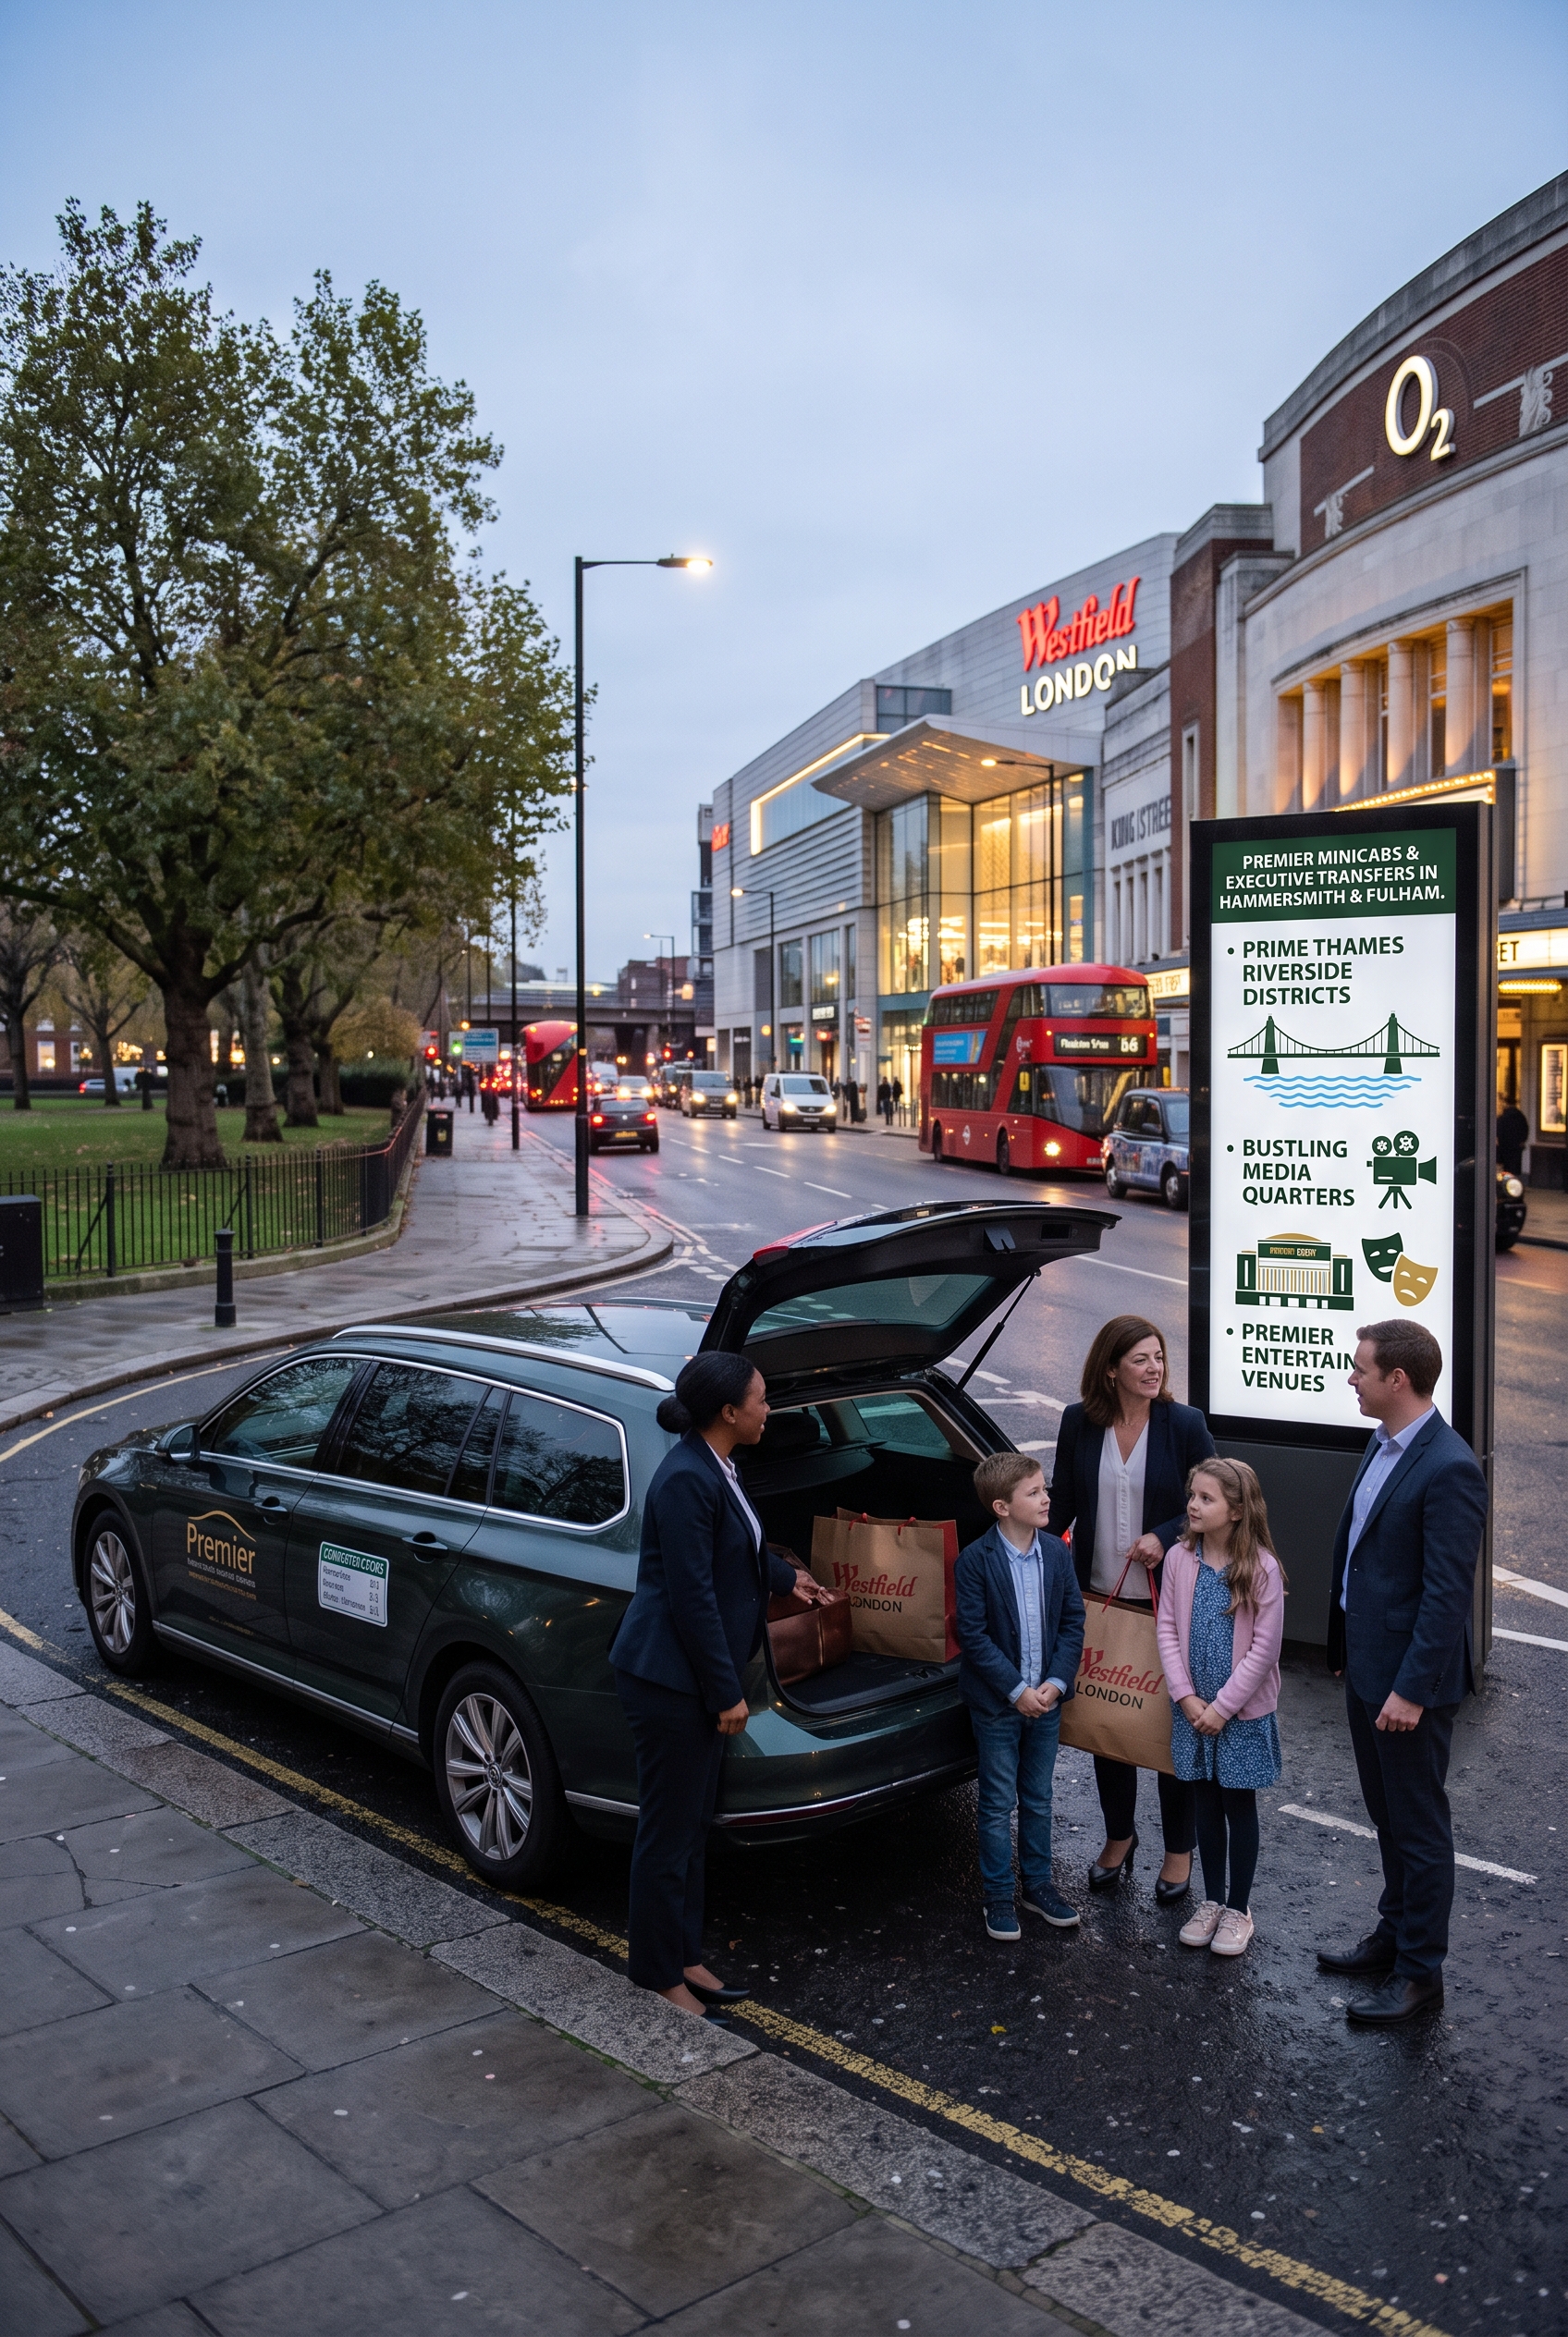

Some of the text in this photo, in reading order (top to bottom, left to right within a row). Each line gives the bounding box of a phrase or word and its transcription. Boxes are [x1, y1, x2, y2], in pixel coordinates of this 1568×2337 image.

[1385, 356, 1456, 461] O2
[1016, 575, 1141, 672] Westfield
[1021, 644, 1137, 716] LONDON
[1243, 845, 1420, 869] PREMIER MINICABS &
[1226, 864, 1438, 889] EXECUTIVE TRANSFERS IN
[1219, 885, 1446, 909] HAMMERSMITH & FULHAM.
[1243, 936, 1404, 959] PRIME THAMES
[1243, 961, 1353, 982] RIVERSIDE
[1243, 986, 1351, 1005] DISTRICTS
[1243, 1139, 1348, 1157] BUSTLING
[1243, 1162, 1312, 1181] MEDIA
[1243, 1186, 1355, 1206] QUARTERS
[1242, 1323, 1334, 1346] PREMIER
[1242, 1369, 1325, 1392] VENUES
[187, 1522, 256, 1574] Premier
[831, 1561, 918, 1597] Westfield
[1079, 1646, 1165, 1695] Westfield
[1075, 1681, 1144, 1710] LONDON
